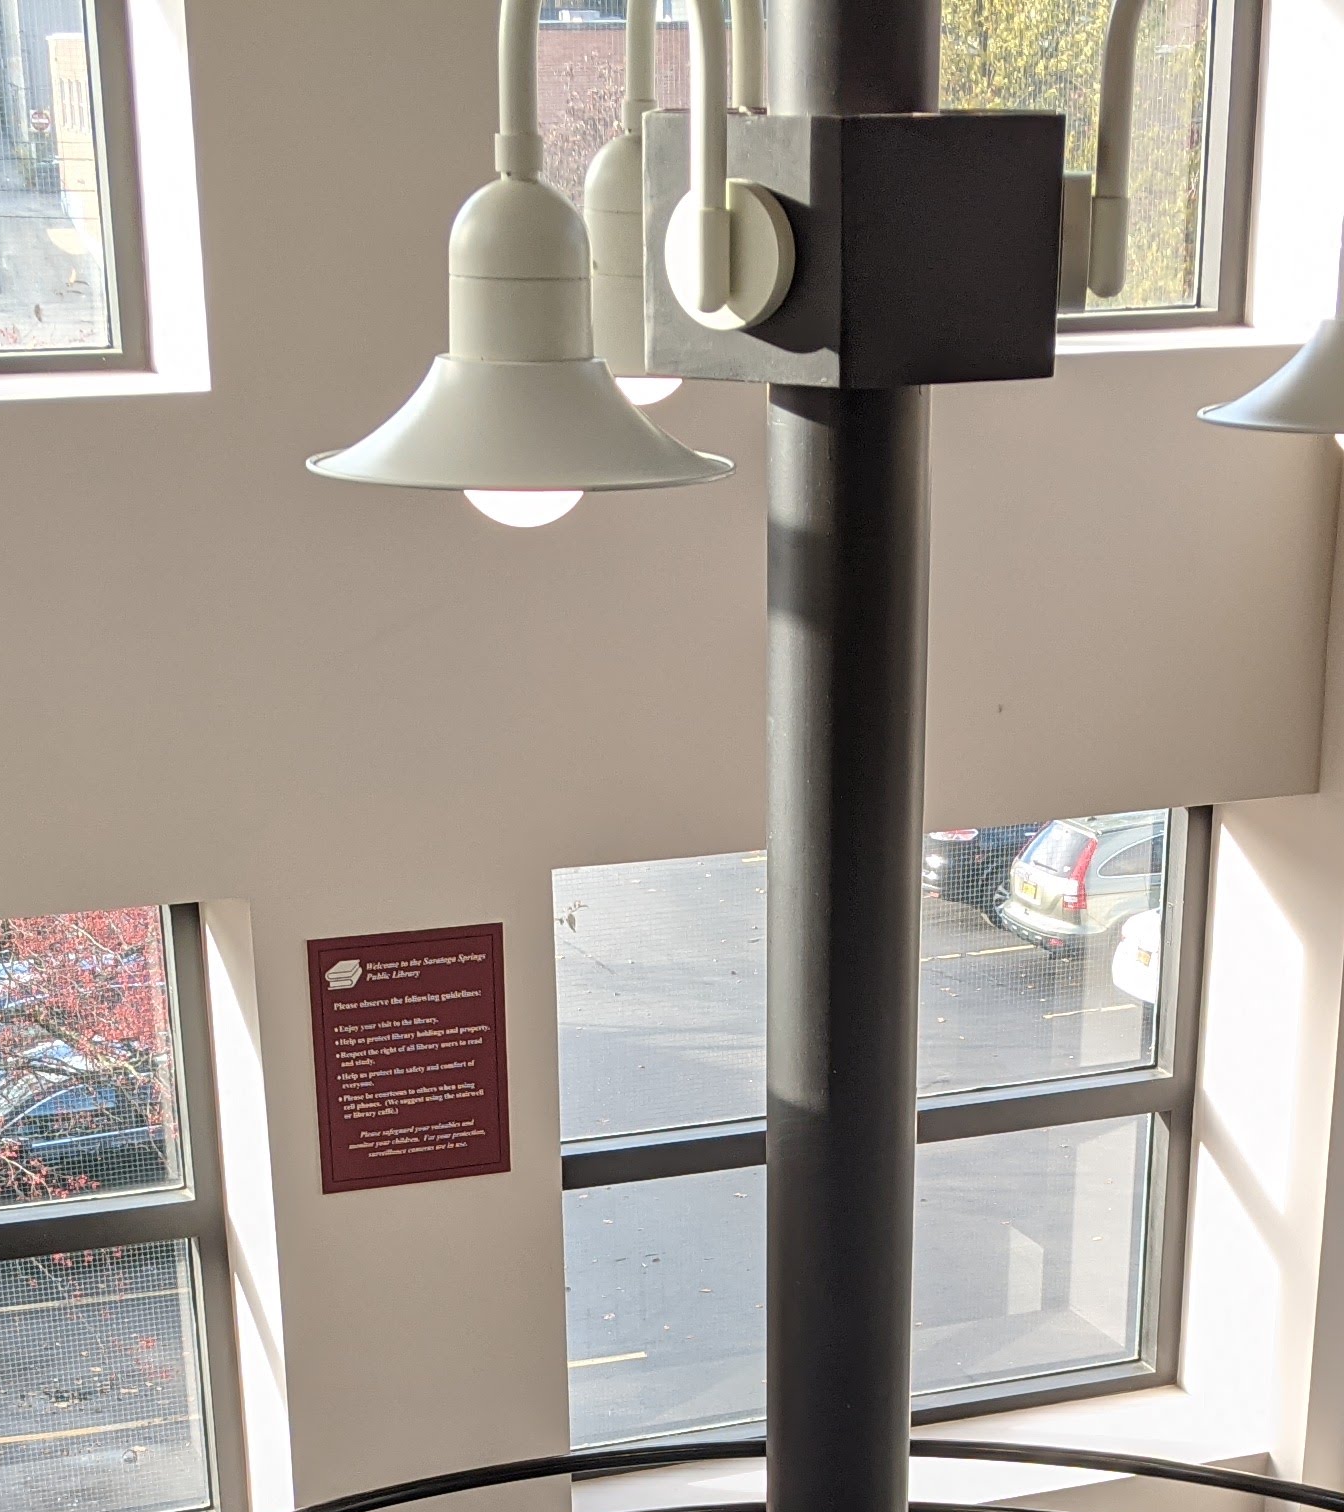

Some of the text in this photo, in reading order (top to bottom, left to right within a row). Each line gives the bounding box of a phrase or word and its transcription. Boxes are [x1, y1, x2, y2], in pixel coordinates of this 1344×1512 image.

[366, 961, 399, 970] Welcome
[409, 958, 421, 967] the
[423, 956, 456, 965] Saratoga
[457, 952, 486, 963] Springs
[366, 970, 420, 981] Public Library
[333, 989, 481, 1011] Please observe the following guidelines:
[339, 1024, 358, 1033] Enjoy
[360, 1023, 376, 1032] your
[378, 1020, 392, 1028] visit
[413, 1017, 439, 1025] library.
[339, 1037, 356, 1046] Help
[366, 1034, 390, 1045] protect
[391, 1032, 415, 1040] library
[445, 1026, 458, 1034] and
[459, 1024, 490, 1035] property.
[340, 1049, 366, 1059] Respect
[379, 1046, 397, 1055] right
[415, 1043, 439, 1051] library
[467, 1037, 482, 1045] read
[341, 1058, 375, 1067] and study.
[341, 1072, 358, 1081] Help
[368, 1069, 392, 1079] protect
[393, 1067, 404, 1075] the
[405, 1065, 425, 1074] safety
[426, 1063, 439, 1071] and
[440, 1061, 466, 1070] comfort
[342, 1080, 374, 1089] everyone.
[343, 1094, 364, 1102] Please
[416, 1086, 437, 1094] others
[343, 1103, 355, 1111] cell
[356, 1101, 382, 1110] phones.
[384, 1098, 399, 1107] (We
[399, 1096, 424, 1105] suggest
[425, 1094, 443, 1102] using
[360, 1130, 381, 1138] Please
[381, 1125, 413, 1136] safeguard
[414, 1125, 429, 1134] your
[461, 1118, 474, 1127] and
[375, 1139, 391, 1148] your
[391, 1136, 420, 1145] children.
[436, 1133, 451, 1141] your
[452, 1129, 485, 1139] protection,
[407, 1145, 434, 1153] cameras
